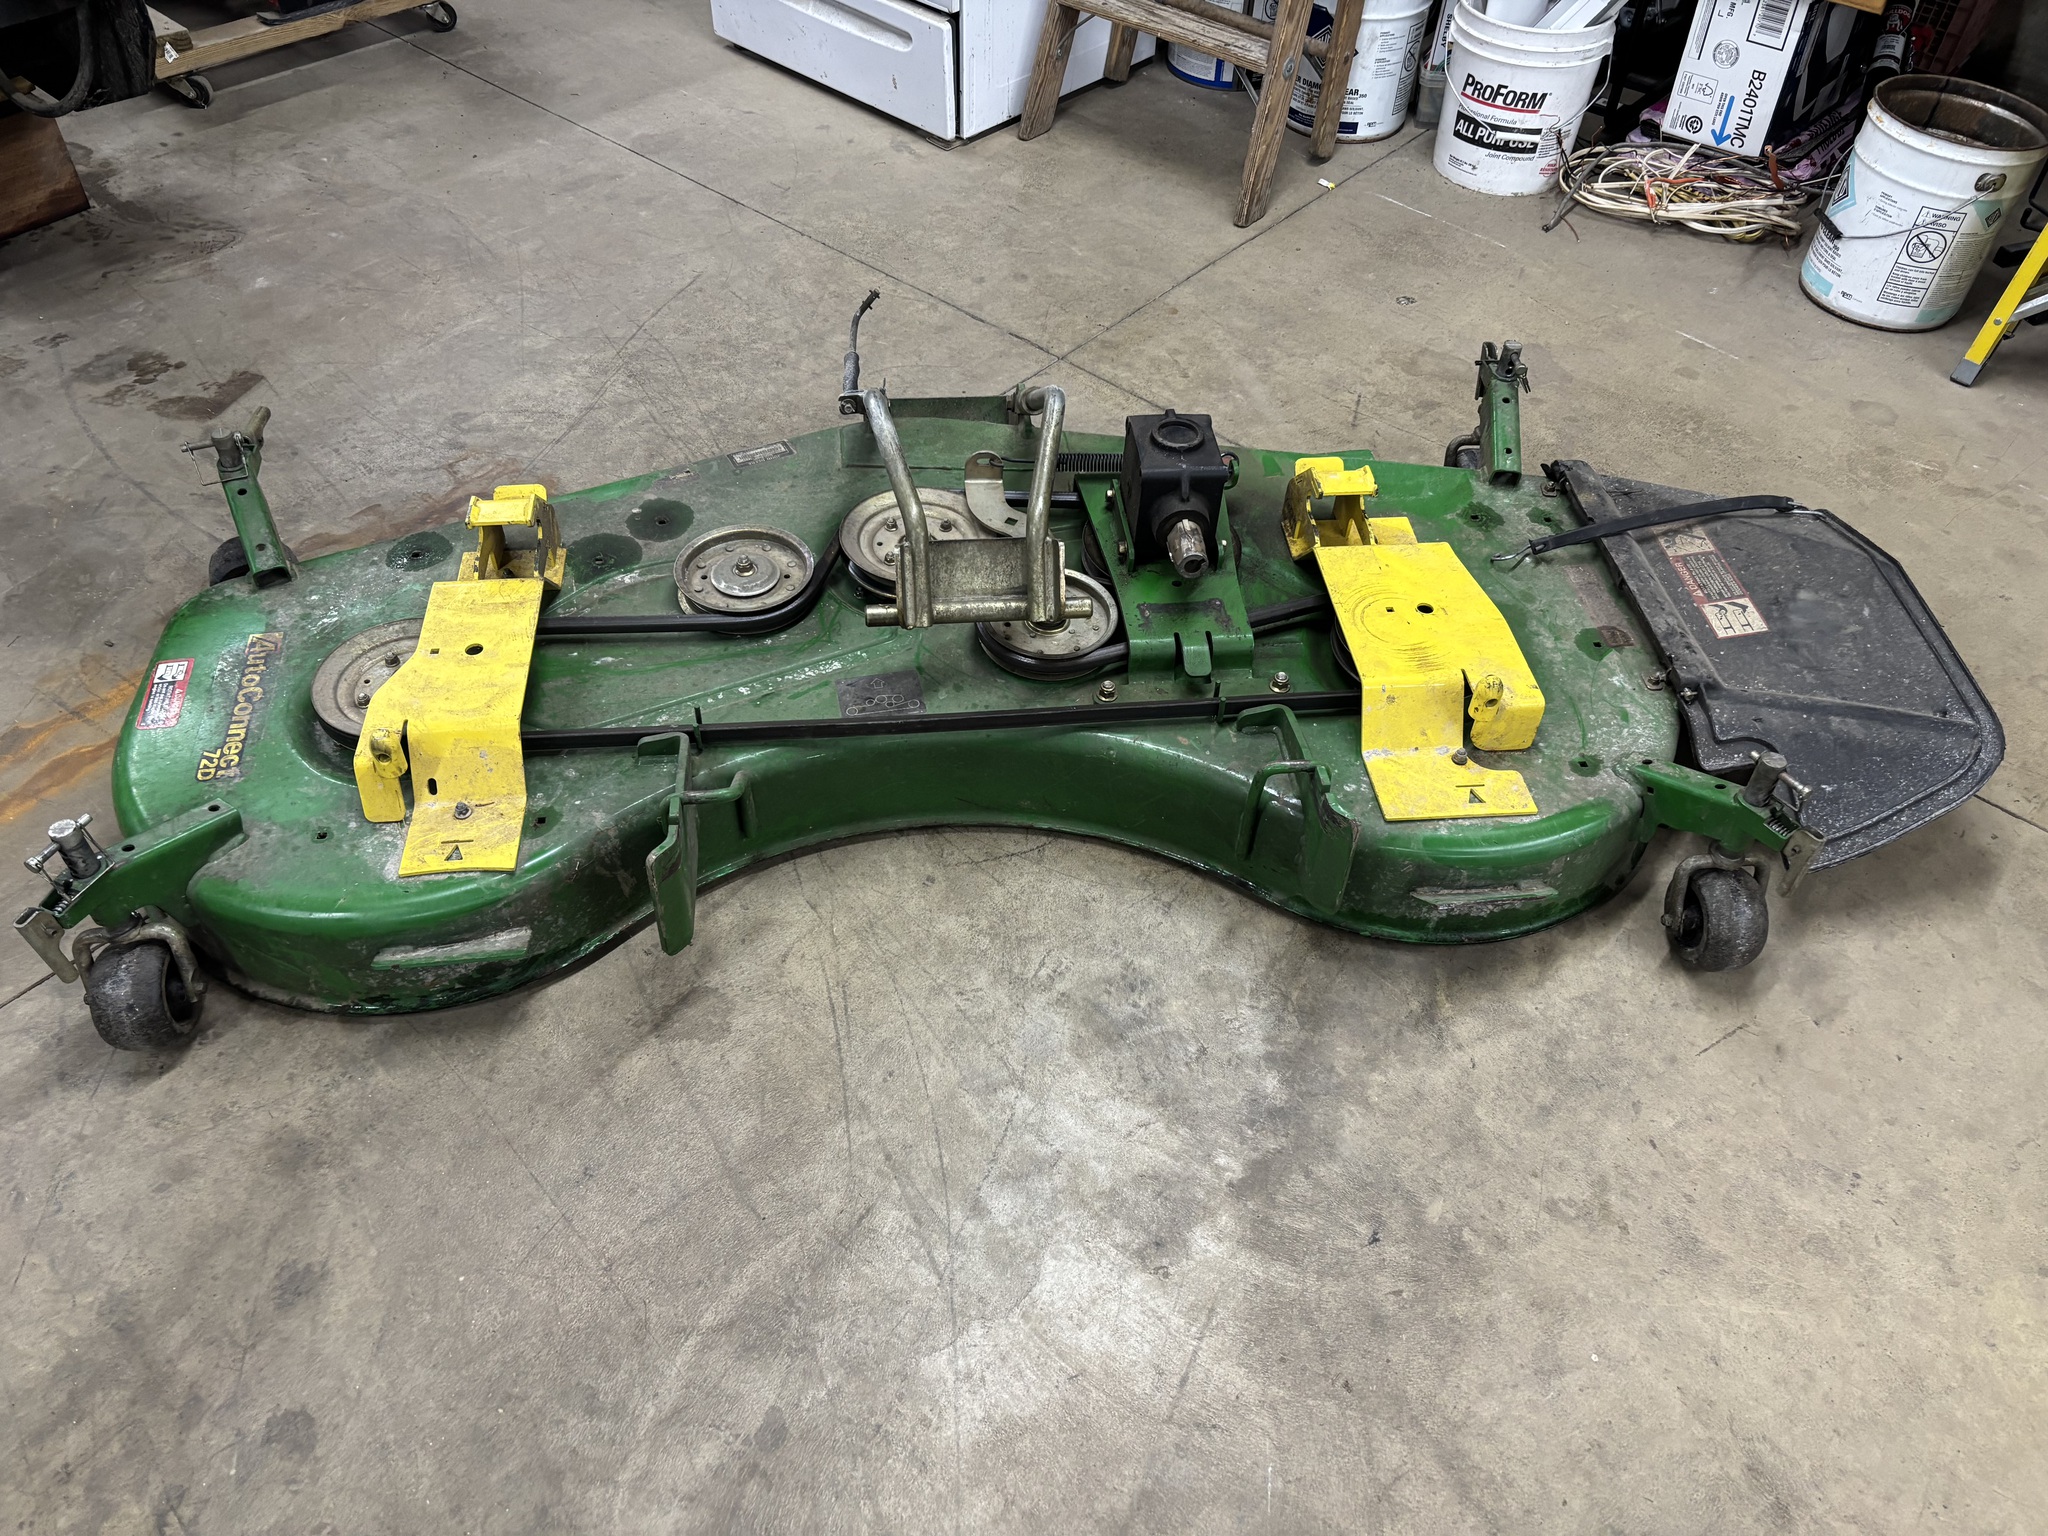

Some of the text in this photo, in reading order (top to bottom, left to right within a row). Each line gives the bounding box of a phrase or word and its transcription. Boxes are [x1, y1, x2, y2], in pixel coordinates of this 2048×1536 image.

[1725, 2, 1737, 19] MFG.
[1490, 113, 1518, 125] Formula
[1730, 69, 1767, 149] B2401TMC
[1455, 119, 1475, 140] ALL
[1485, 152, 1535, 162] Joint Compound
[1674, 562, 1697, 591] DANGER
[216, 636, 279, 779] AutoConnect
[196, 748, 222, 782] 72D
